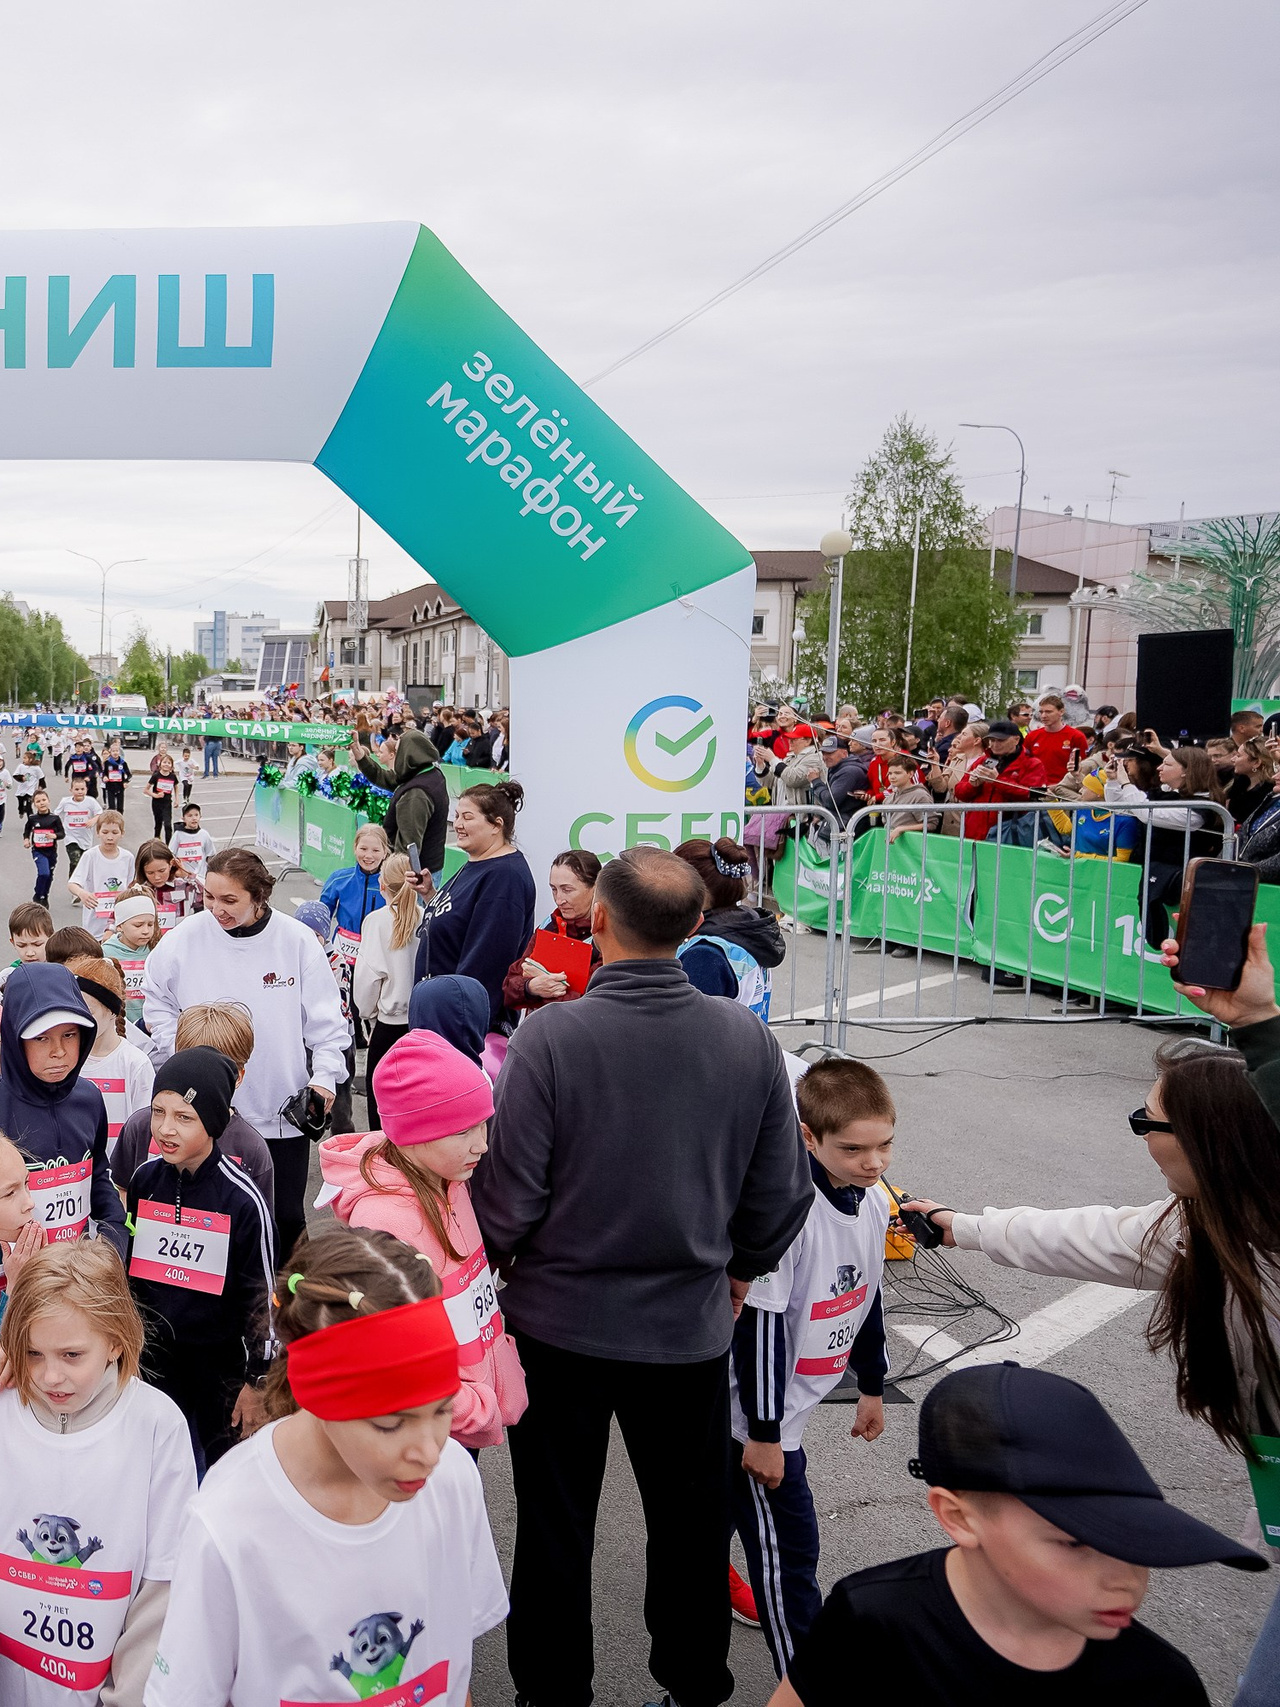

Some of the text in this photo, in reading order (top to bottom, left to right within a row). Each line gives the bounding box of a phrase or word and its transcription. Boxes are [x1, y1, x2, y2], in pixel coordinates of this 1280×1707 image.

[462, 350, 645, 529] зелёный
[425, 380, 607, 562] марафон
[55, 712, 126, 728] СТАРТ
[140, 716, 211, 733] СТАРТ
[224, 721, 293, 739] СТАРТ
[45, 1195, 83, 1222] 2701
[55, 1227, 78, 1241] 400м
[157, 1236, 205, 1263] 2647
[164, 1267, 190, 1283] 400м
[827, 1322, 855, 1350] 2824
[17, 1570, 37, 1581] СБЕР
[39, 1601, 70, 1615] 7-9 ЛЕТ
[22, 1609, 95, 1651] 2608
[40, 1656, 77, 1683] 400м
